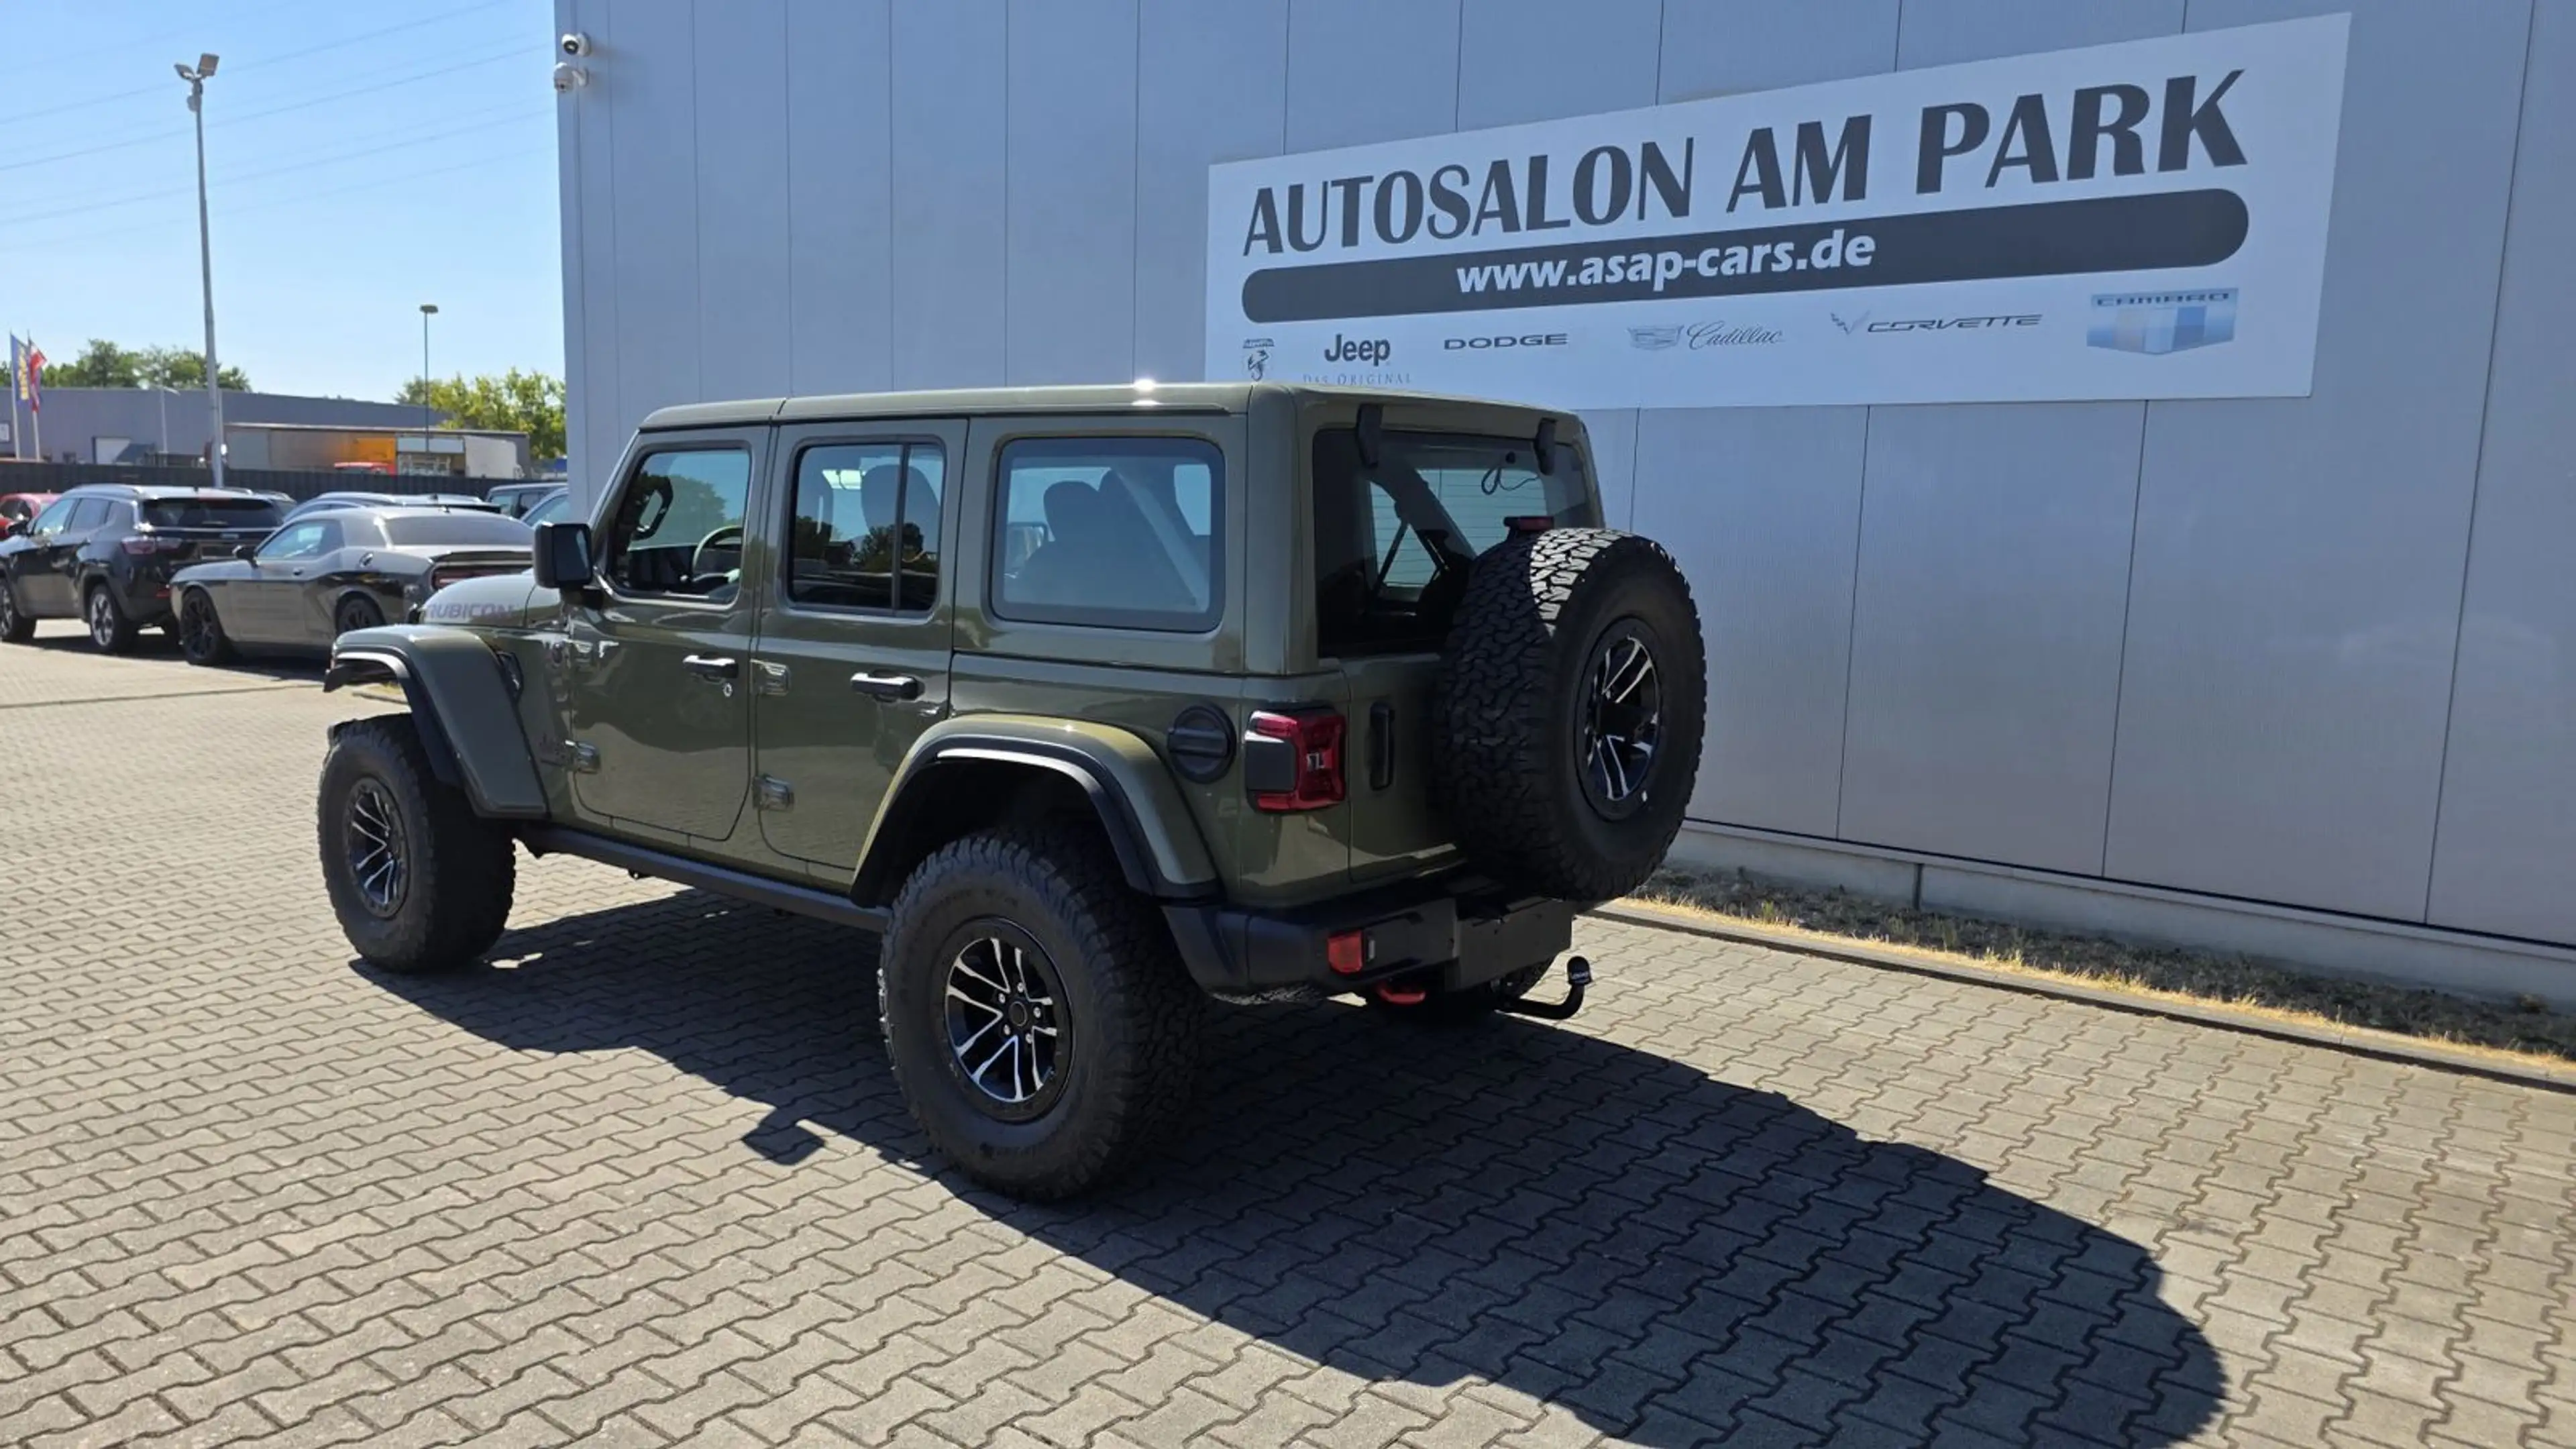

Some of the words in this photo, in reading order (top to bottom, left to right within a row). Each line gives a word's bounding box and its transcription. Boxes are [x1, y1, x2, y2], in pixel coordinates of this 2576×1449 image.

[1244, 138, 1693, 257] AUTOSALON
[1727, 114, 1872, 213] AM
[1916, 69, 2247, 195] PARK
[1456, 228, 1876, 293] www.asap-cars.de
[2096, 292, 2230, 306] CAMARO
[1686, 321, 1783, 350] Cadillac
[1868, 314, 2043, 333] CORVETTE
[1324, 333, 1390, 366] Jeep
[1444, 333, 1568, 350] DODGE
